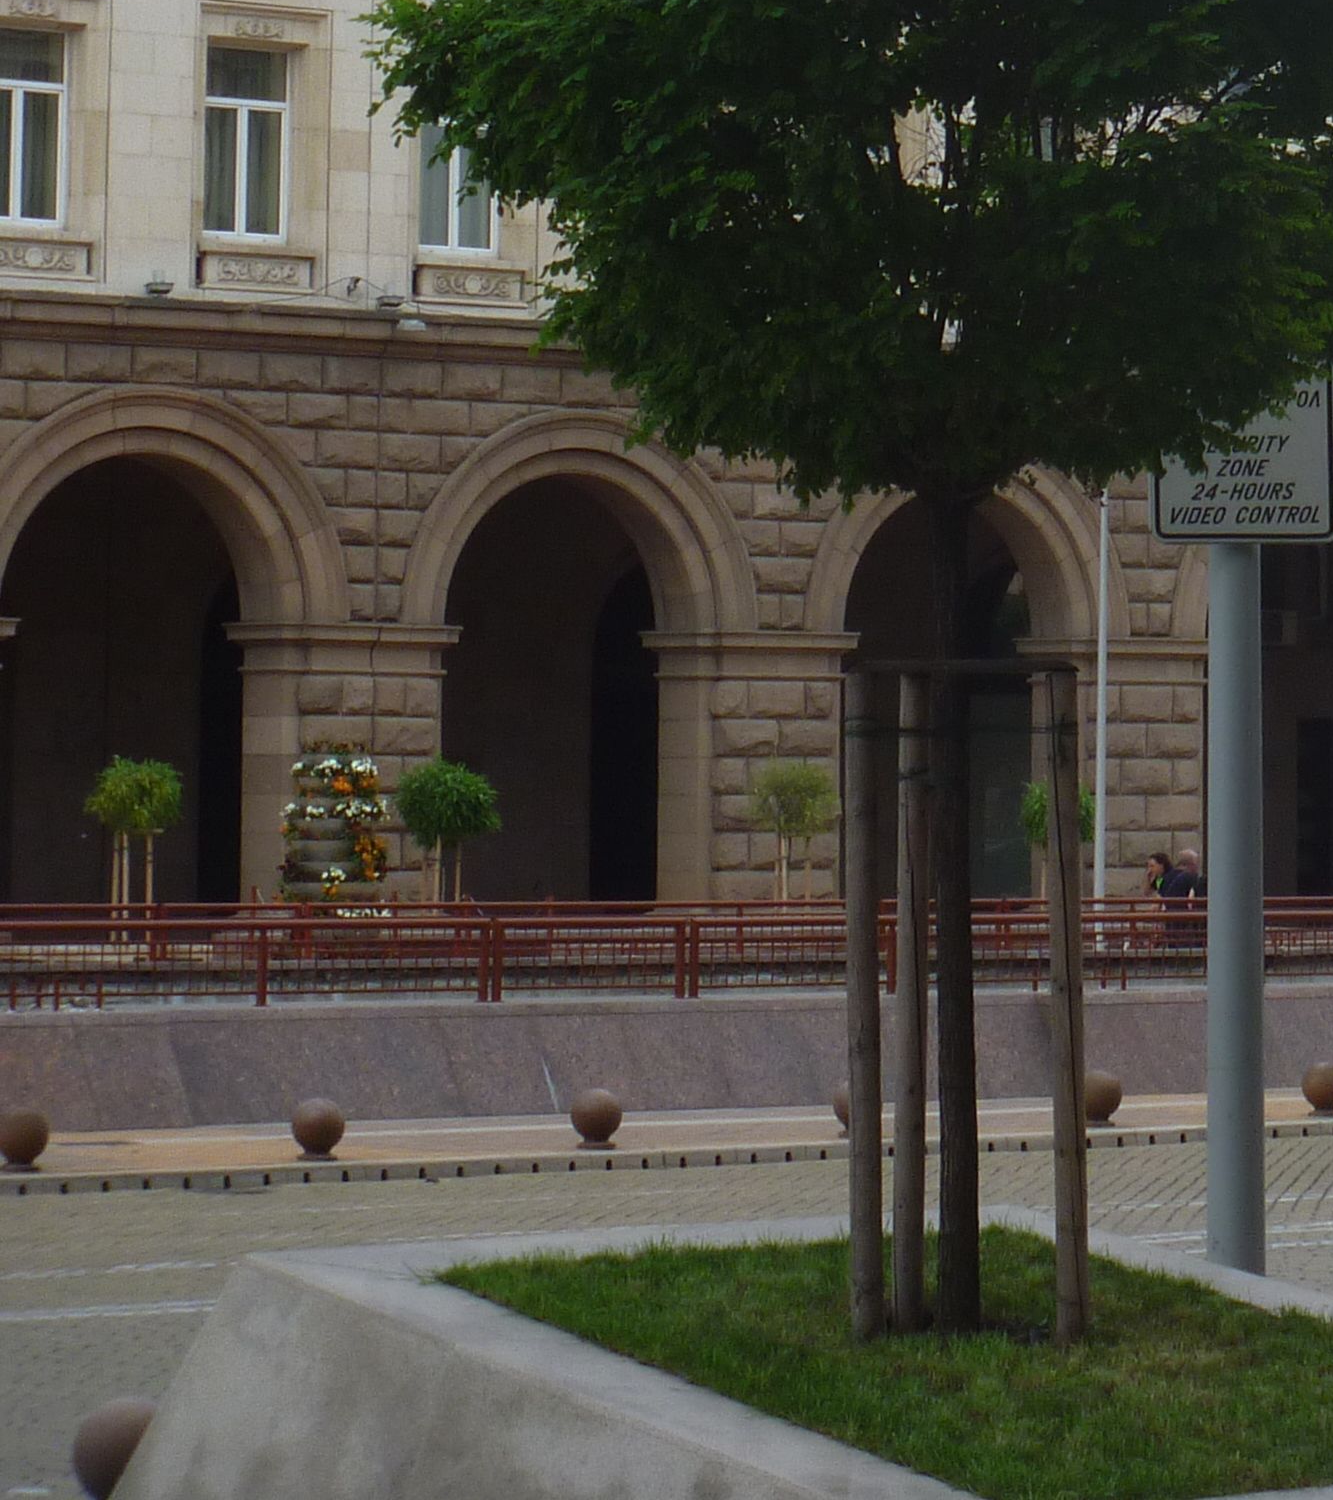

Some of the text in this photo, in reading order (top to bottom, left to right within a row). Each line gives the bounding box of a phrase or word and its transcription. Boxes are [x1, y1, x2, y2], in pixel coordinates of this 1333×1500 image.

[1216, 459, 1270, 477] ZONE
[1191, 482, 1296, 501] 24-HOURS
[1170, 505, 1320, 525] VIDEO CONTROL
